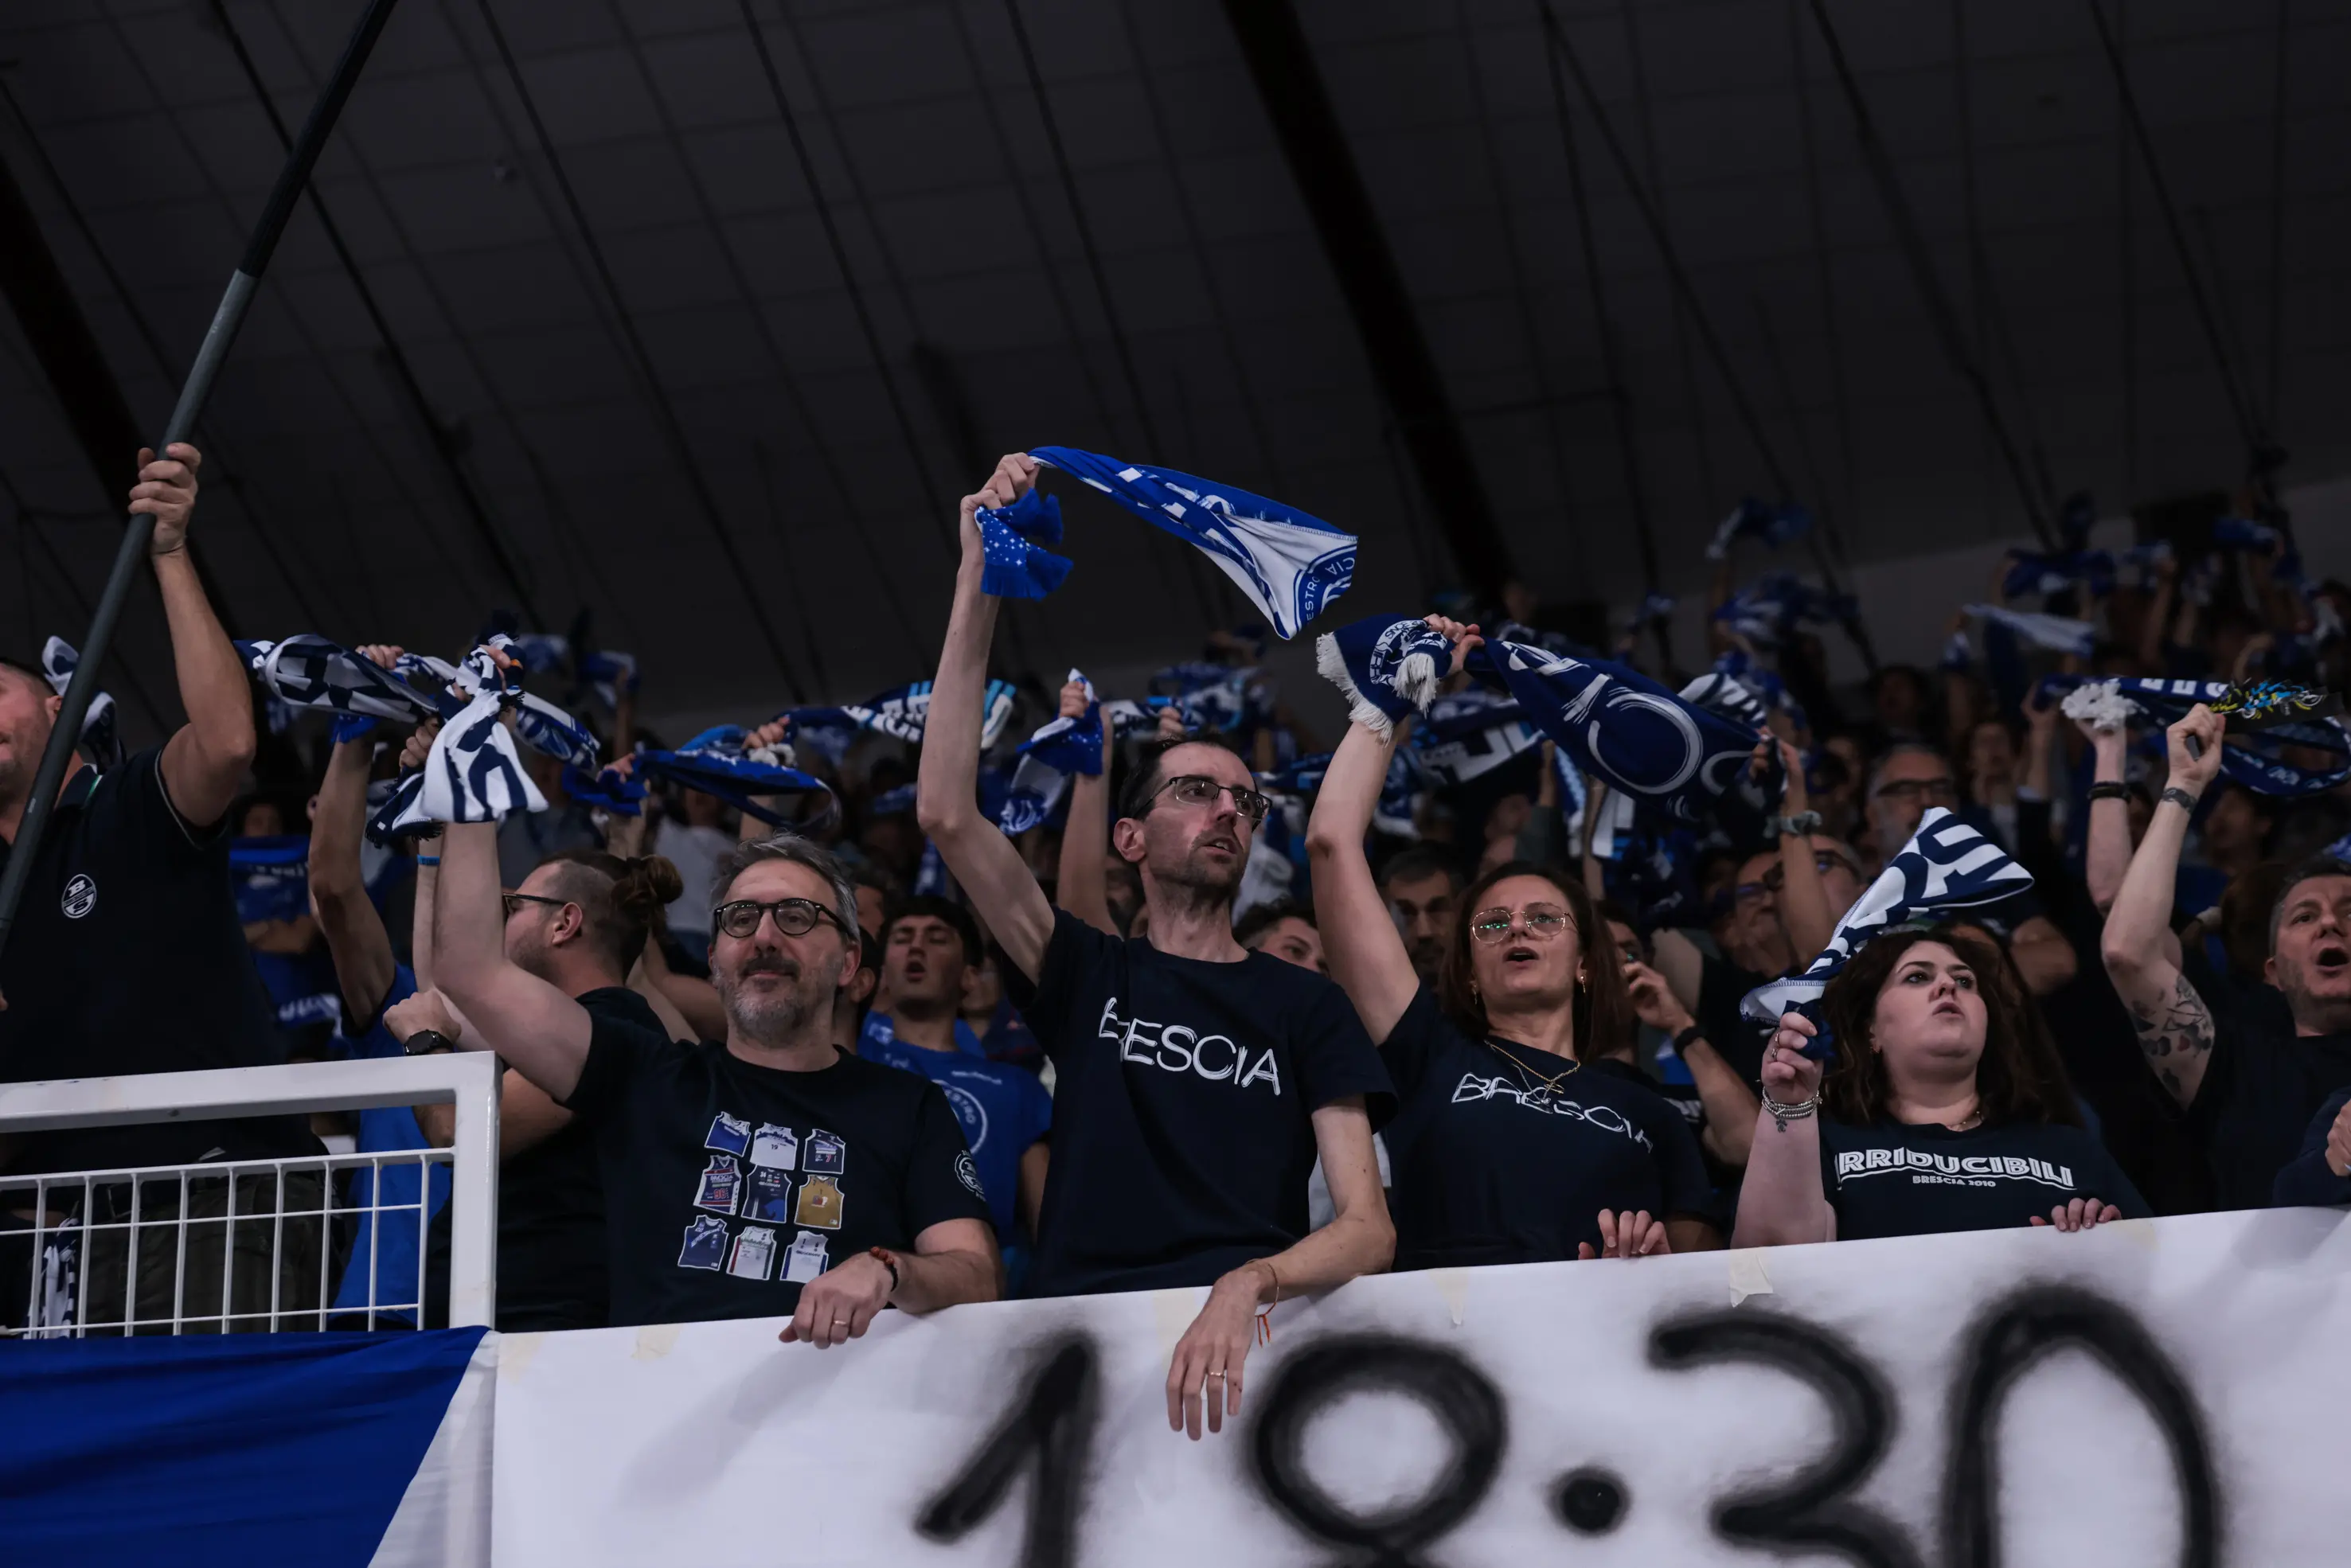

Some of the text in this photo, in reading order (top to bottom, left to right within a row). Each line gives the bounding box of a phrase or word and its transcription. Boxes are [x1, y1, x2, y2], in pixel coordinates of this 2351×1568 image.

[1834, 1147, 2074, 1188] RRIDUCIBILI
[1912, 1175, 1996, 1188] BRESCIA 2010
